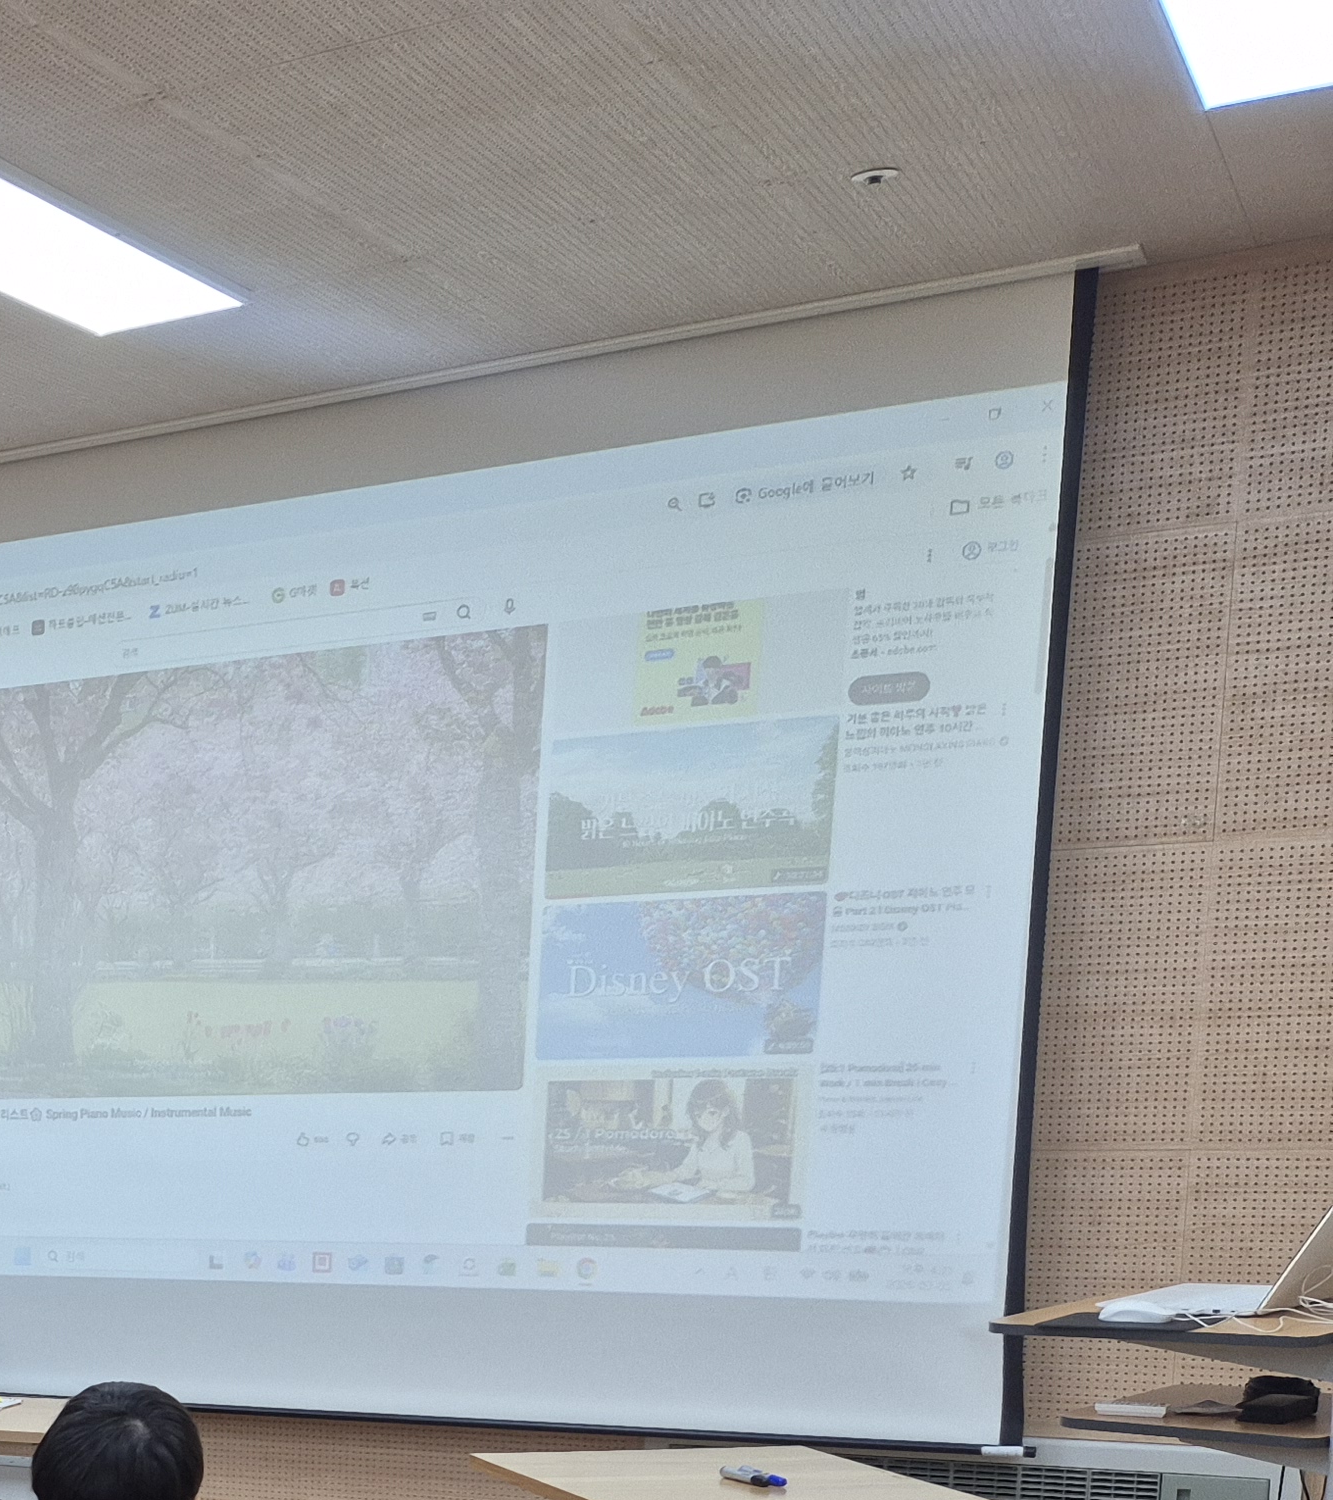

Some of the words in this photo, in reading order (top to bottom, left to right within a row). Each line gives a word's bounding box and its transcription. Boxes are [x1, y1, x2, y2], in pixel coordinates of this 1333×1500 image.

[567, 962, 689, 1003] Disney
[703, 957, 792, 993] OST
[46, 1108, 78, 1121] Spring
[80, 1107, 108, 1119] Piano
[111, 1107, 142, 1119] Music
[151, 1106, 217, 1118] Instrumental
[220, 1106, 252, 1118] Music
[594, 1126, 675, 1140] Pomodoro
